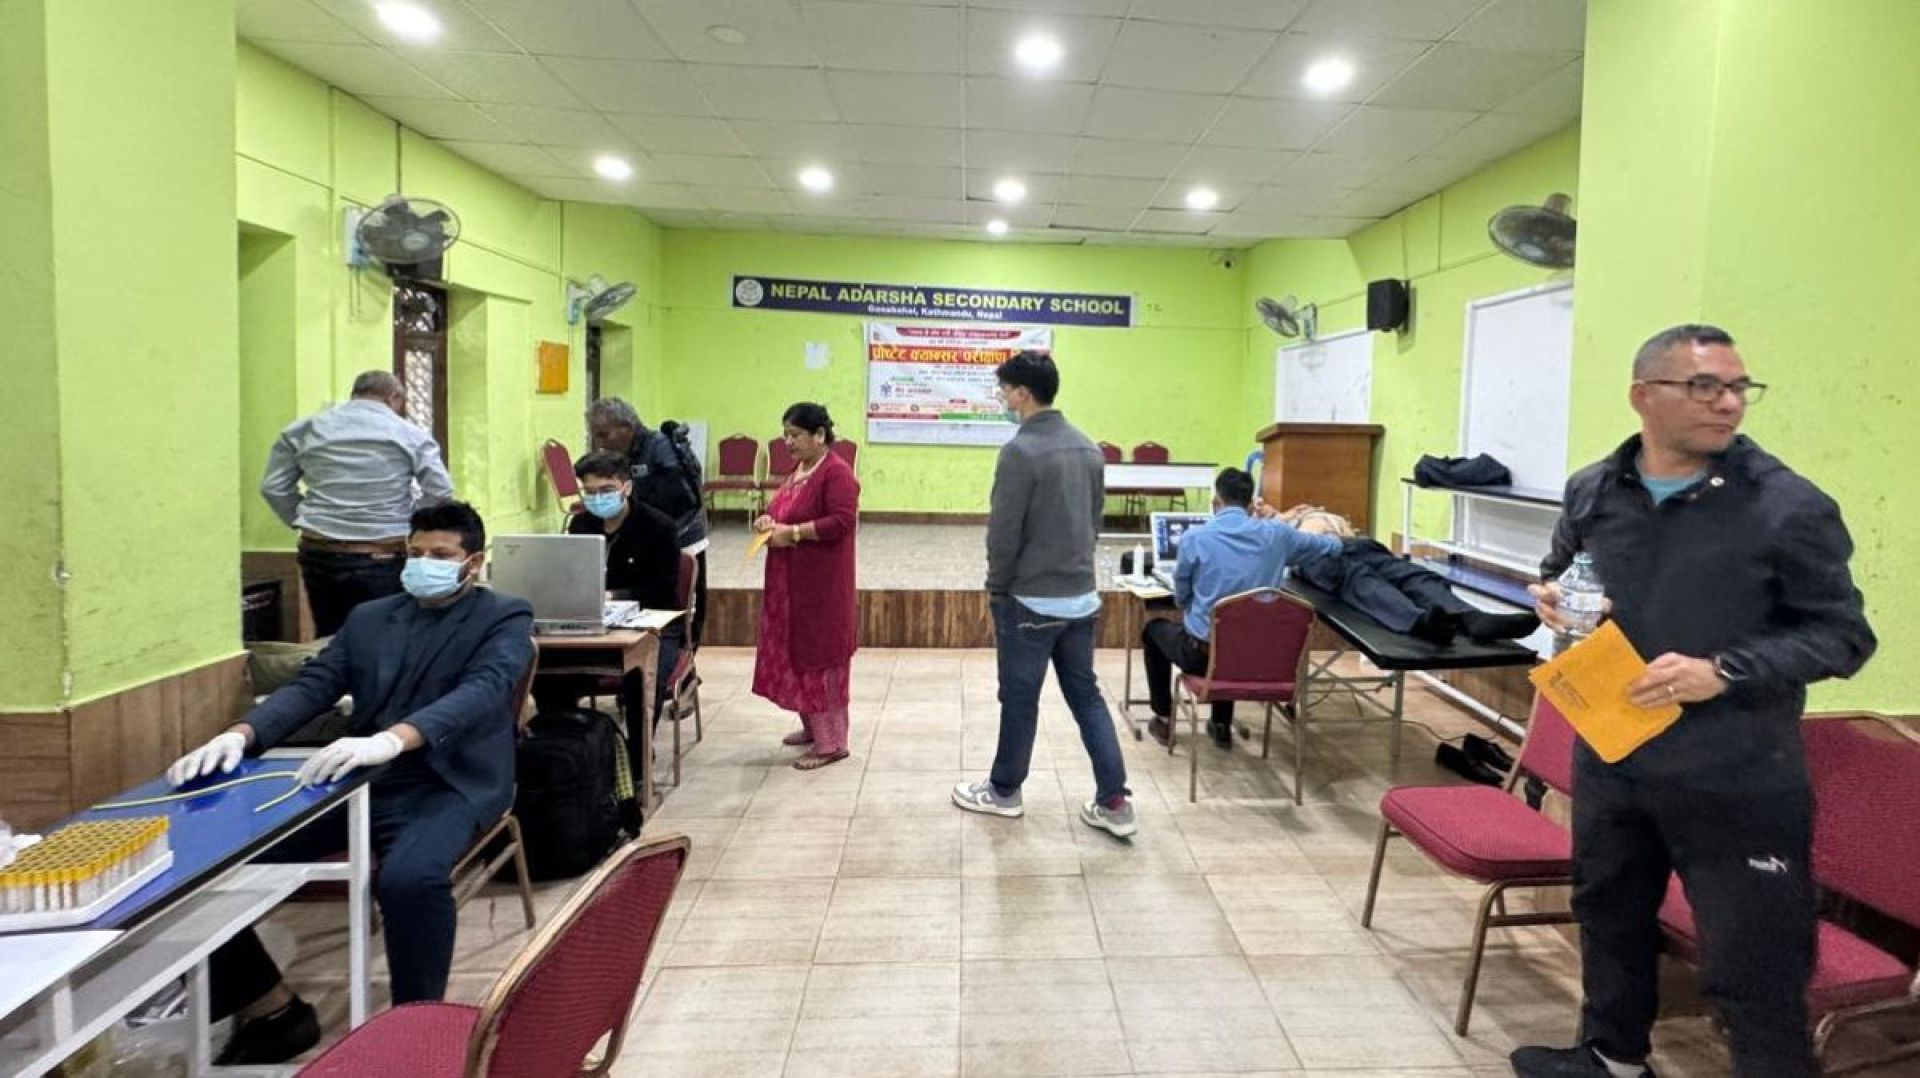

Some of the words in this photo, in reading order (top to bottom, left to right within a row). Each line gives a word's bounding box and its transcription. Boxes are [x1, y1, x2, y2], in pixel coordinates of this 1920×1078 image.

[770, 283, 832, 302] NEPAL
[837, 287, 927, 306] ADARSHA
[932, 292, 1044, 312] SECONDARY
[1050, 298, 1125, 315] SCHOOL
[921, 306, 973, 319] Kathmandu,
[976, 309, 1003, 321] Nepal
